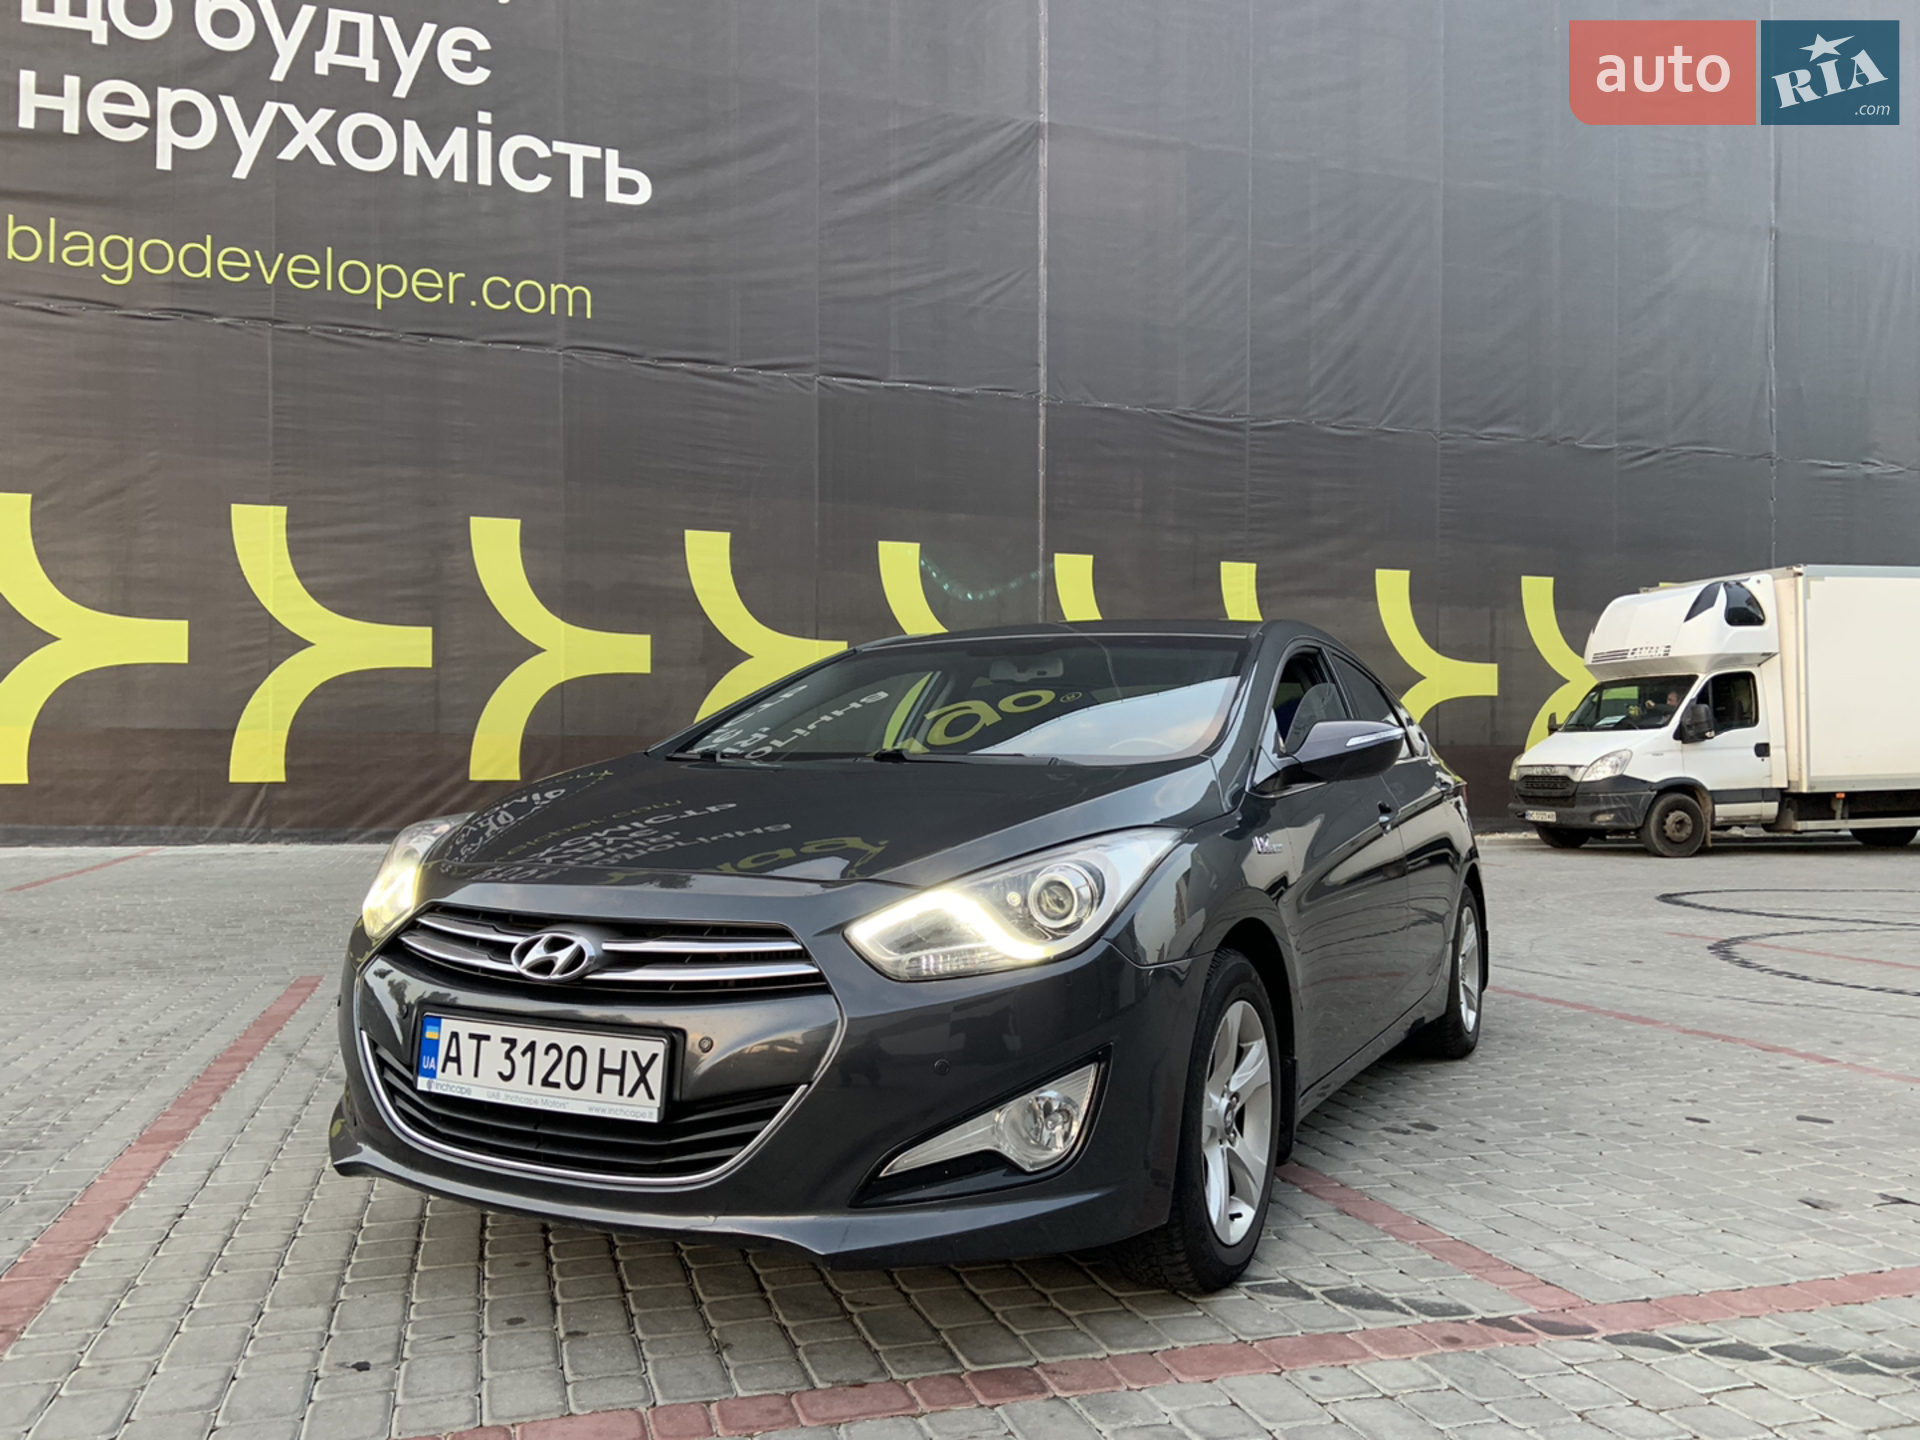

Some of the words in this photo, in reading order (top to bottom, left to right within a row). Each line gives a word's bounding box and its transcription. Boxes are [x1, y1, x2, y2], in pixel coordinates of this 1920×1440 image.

[194, 0, 492, 99] будує
[18, 68, 653, 206] нерухомість
[6, 214, 593, 319] blagodeveloper.com
[422, 1056, 436, 1070] UA
[441, 1031, 491, 1078] AT
[497, 1037, 588, 1091] 3120
[596, 1047, 659, 1100] HX
